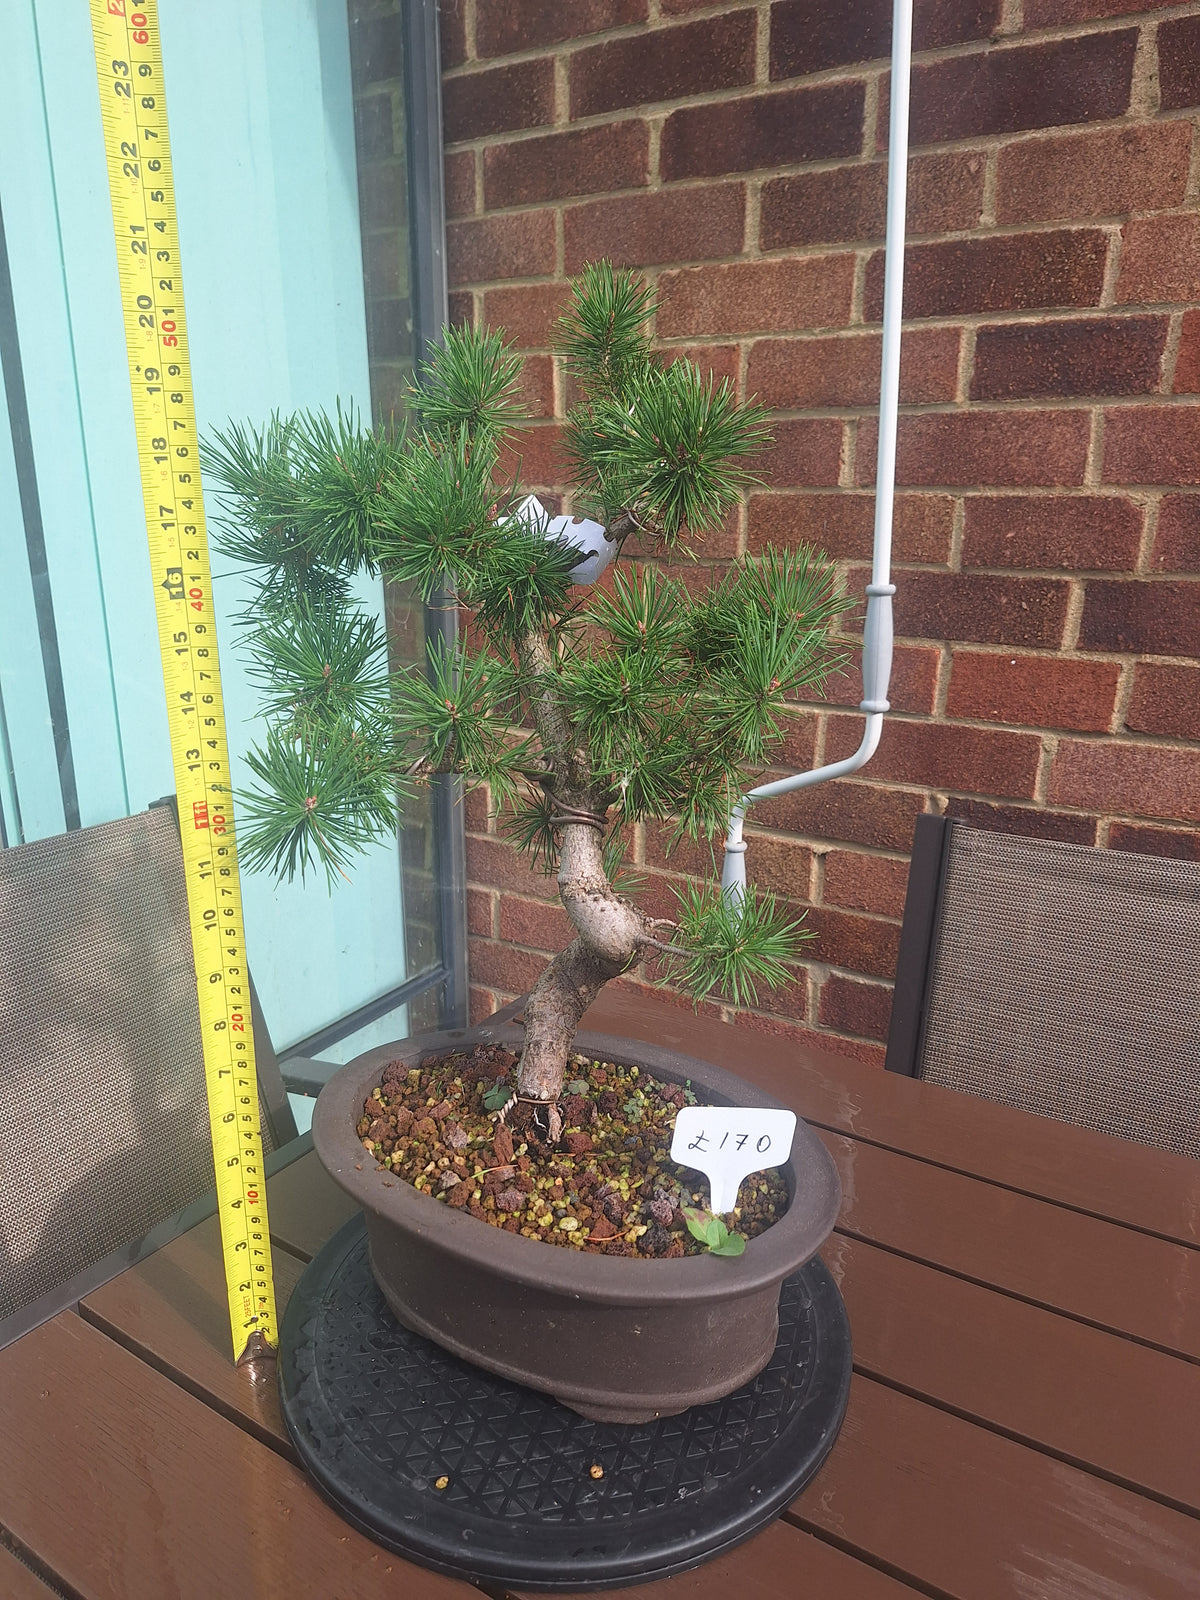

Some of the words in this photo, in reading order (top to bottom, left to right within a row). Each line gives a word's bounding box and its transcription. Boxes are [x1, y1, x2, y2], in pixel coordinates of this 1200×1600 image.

[131, 13, 149, 44] 60
[138, 64, 152, 77] 9
[112, 60, 131, 98] 23
[142, 97, 155, 109] 8
[145, 129, 158, 140] 7
[121, 142, 140, 178] 22
[148, 159, 161, 171] 6
[151, 190, 164, 202] 5
[154, 221, 166, 233] 4
[130, 225, 147, 255] 21
[157, 251, 170, 262] 3
[159, 280, 172, 291] 2
[137, 295, 154, 328] 20
[161, 320, 178, 347] 50
[168, 365, 181, 376] 9
[144, 367, 161, 395] 19
[171, 393, 183, 404] 8
[173, 421, 186, 430] 7
[152, 437, 168, 464] 18
[176, 447, 188, 457] 6
[179, 474, 191, 483] 5
[182, 500, 193, 510] 4
[159, 505, 175, 531] 17
[184, 525, 196, 535] 3
[187, 551, 199, 560] 2
[168, 571, 183, 595] 16
[189, 588, 203, 612] 40
[195, 624, 206, 634] 9
[173, 632, 189, 656] 15
[197, 648, 209, 657] 8
[200, 672, 211, 681] 7
[180, 691, 195, 715] 14
[202, 695, 213, 704] 6
[205, 718, 216, 726] 5
[207, 740, 218, 749] 4
[186, 748, 201, 772] 13
[209, 762, 220, 770] 3
[213, 815, 226, 835] 30
[217, 847, 228, 856] 9
[198, 861, 212, 879] 11
[220, 868, 230, 876] 8
[221, 888, 232, 896] 7
[223, 908, 234, 916] 6
[203, 909, 217, 931] 10
[226, 928, 236, 936] 5
[227, 948, 237, 956] 4
[229, 967, 239, 975] 3
[209, 973, 222, 984] 9
[214, 1021, 227, 1031] 8
[231, 1013, 244, 1032] 20
[218, 1070, 231, 1079] 7
[222, 1113, 235, 1123] 6
[687, 1129, 771, 1153] £170
[227, 1157, 239, 1167] 5
[247, 1190, 258, 1205] 10
[231, 1200, 243, 1209] 4
[251, 1216, 261, 1224] 9
[235, 1242, 247, 1252] 3
[239, 1282, 251, 1292] 2
